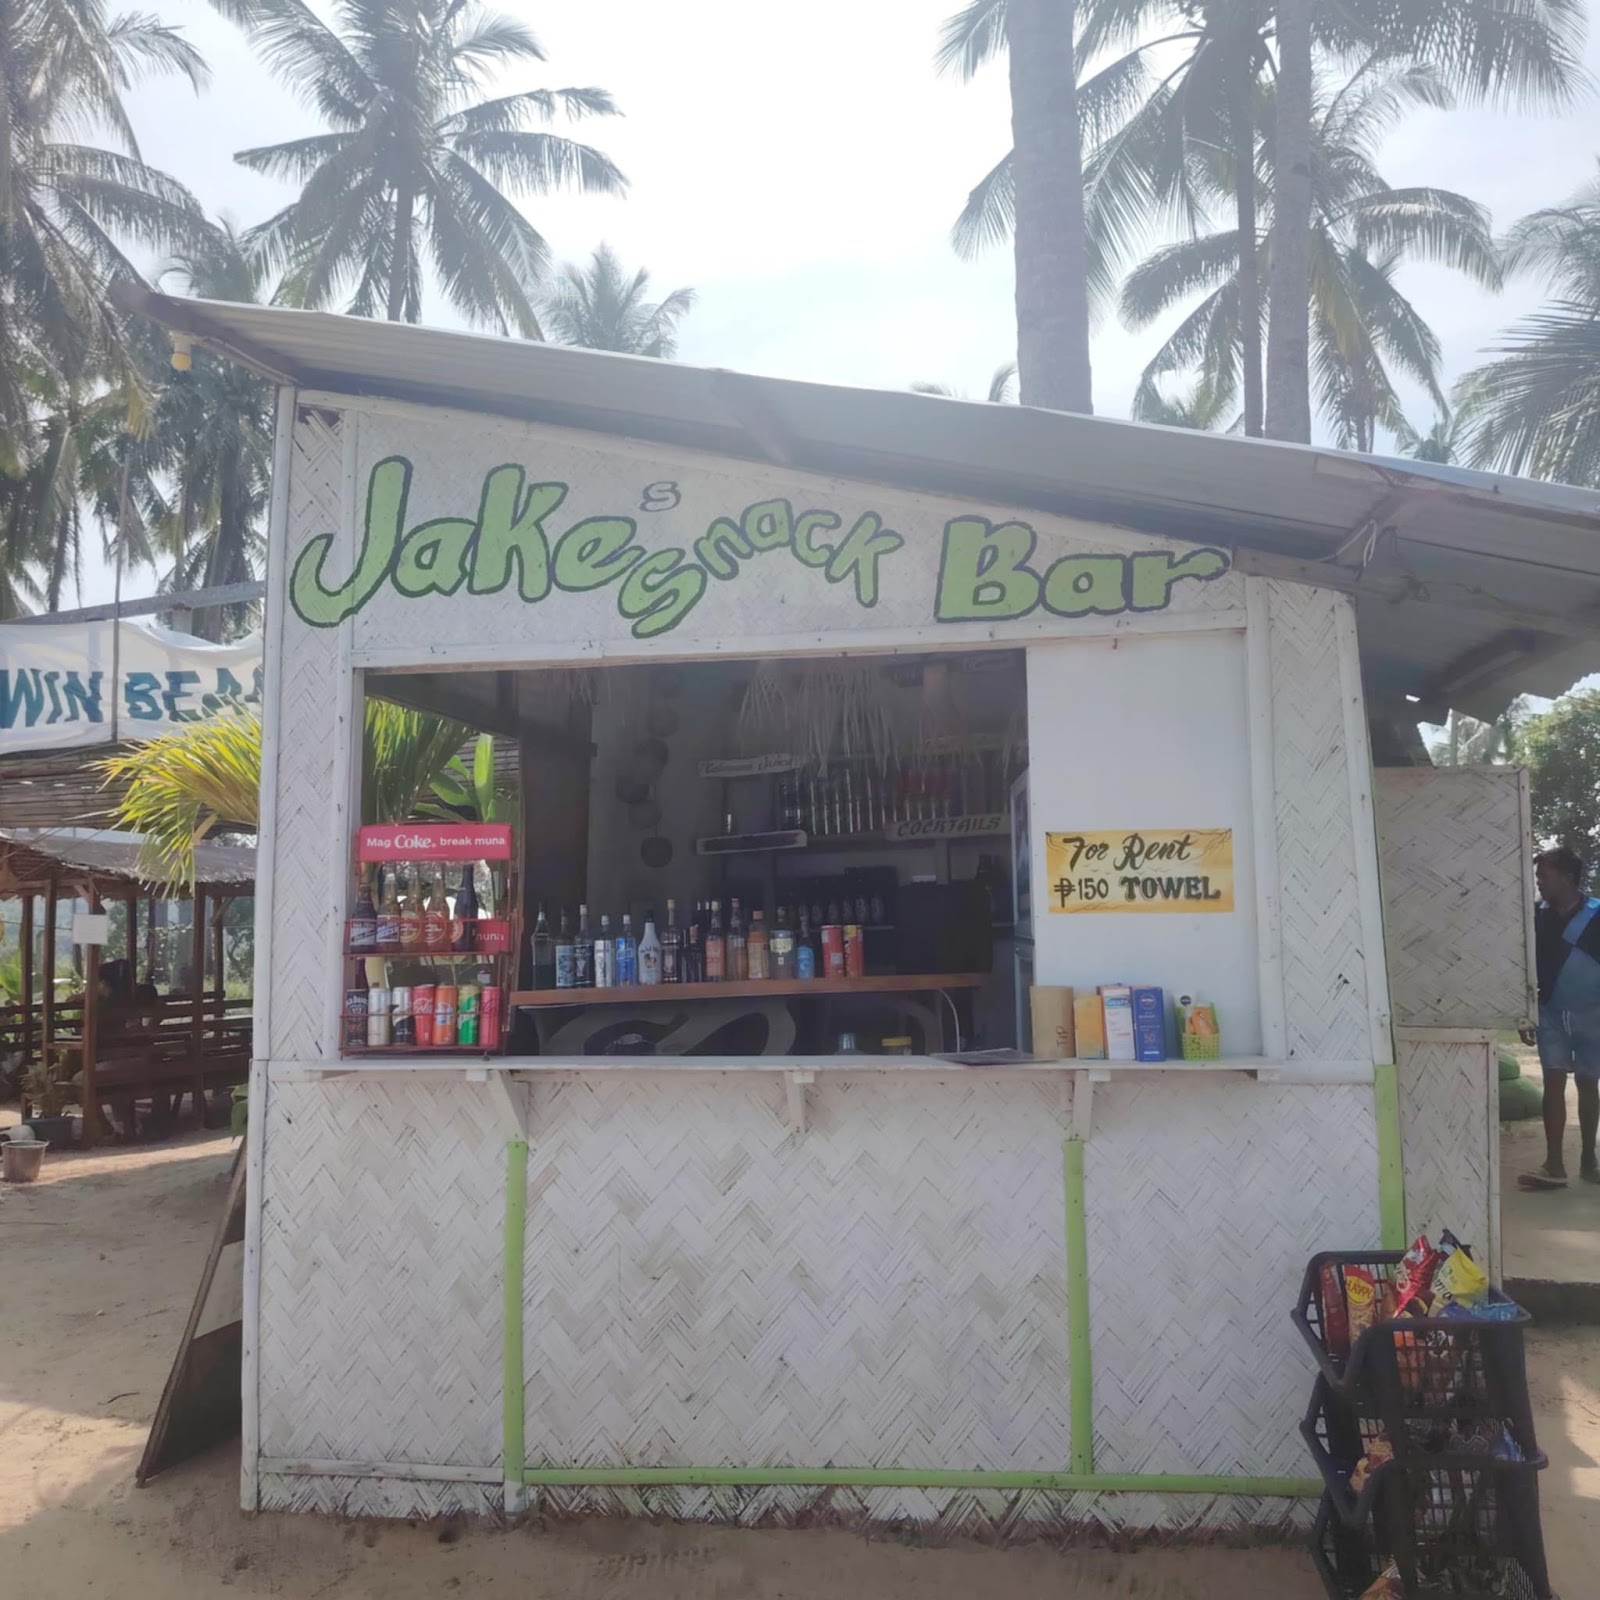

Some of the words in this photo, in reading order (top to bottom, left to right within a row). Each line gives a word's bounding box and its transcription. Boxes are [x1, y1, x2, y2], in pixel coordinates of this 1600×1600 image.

[934, 514, 1232, 623] Bar
[896, 816, 1001, 837] COCKTAILS
[366, 838, 391, 849] Mag
[440, 837, 473, 846] break
[475, 837, 505, 846] muna
[1062, 836, 1109, 873] For
[1113, 832, 1193, 871] Rent
[1119, 876, 1221, 902] TOWEL
